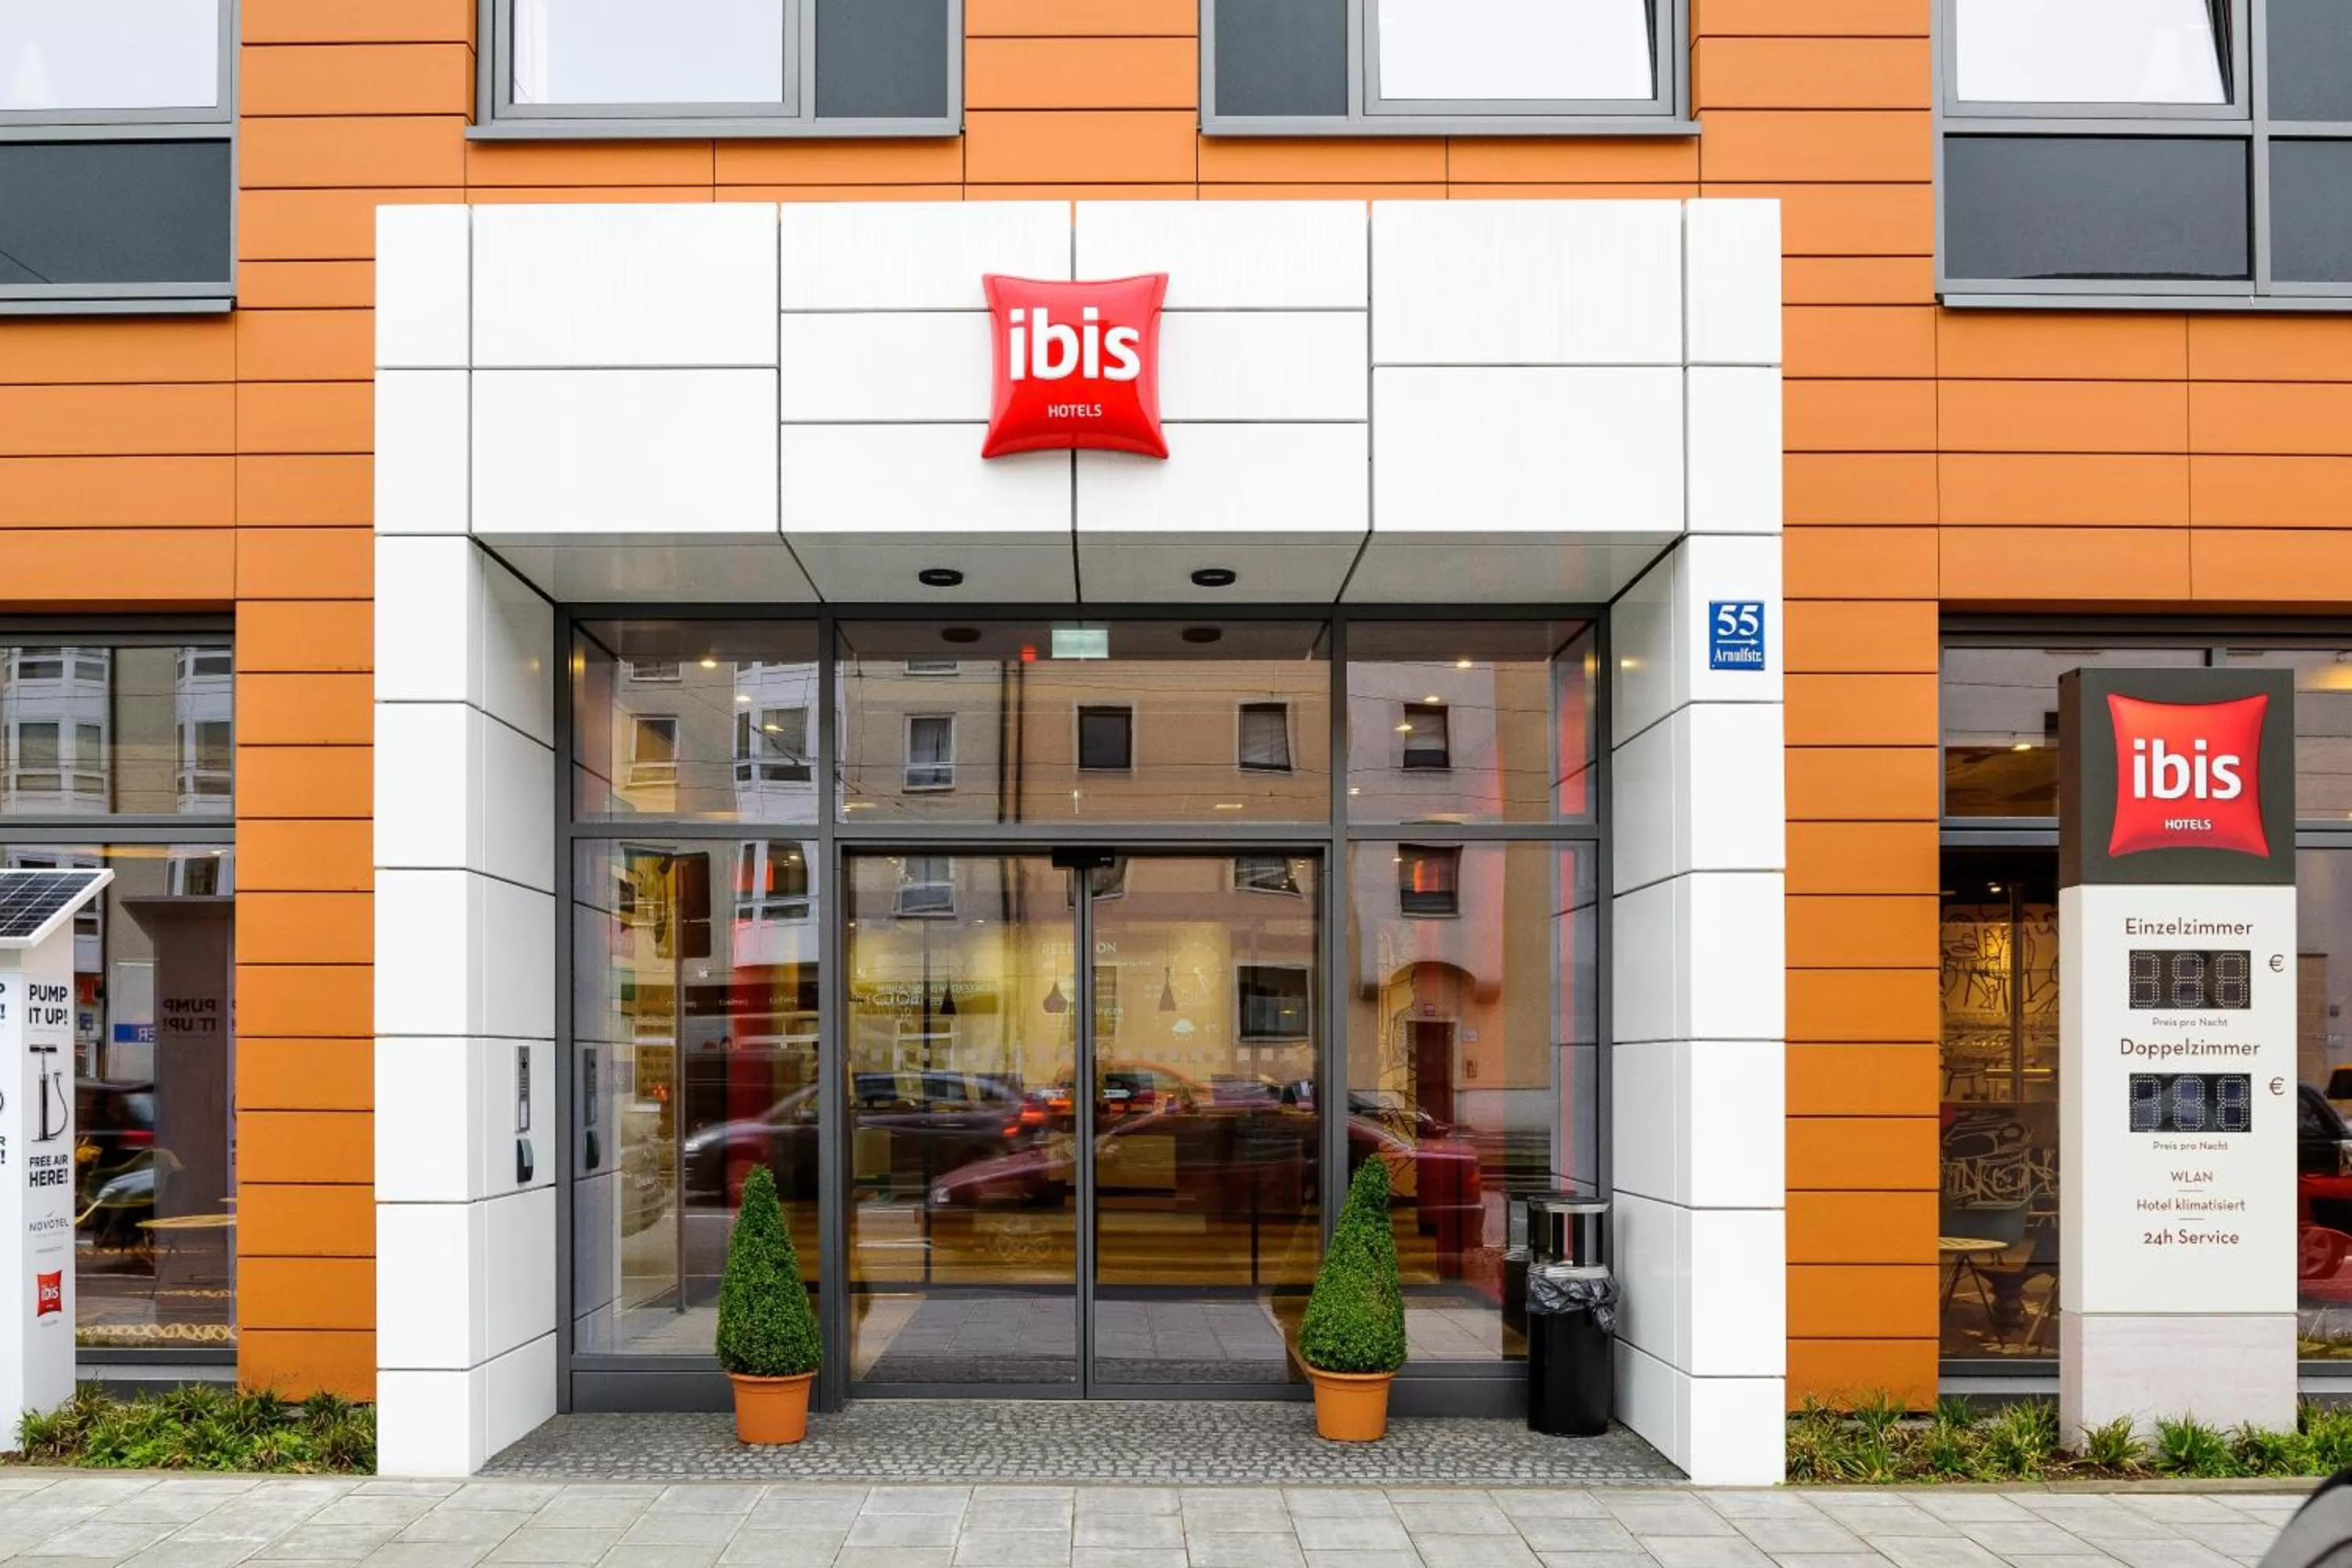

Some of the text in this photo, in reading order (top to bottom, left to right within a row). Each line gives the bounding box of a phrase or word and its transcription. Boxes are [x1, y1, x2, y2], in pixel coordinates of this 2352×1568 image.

[1009, 307, 1142, 381] ibis
[1047, 404, 1103, 418] HOTELS
[1717, 604, 1759, 636] 55
[2133, 738, 2242, 800] ibis
[2165, 819, 2212, 830] HOTELS
[2125, 916, 2254, 935] Einzelzimmer
[2268, 953, 2285, 973] €
[29, 984, 68, 1003] PUMP
[29, 1007, 68, 1025] IT UP!
[2152, 1017, 2228, 1029] Preis pro Nacht
[2120, 1037, 2261, 1059] Doppelzimmer
[2268, 1076, 2285, 1095] €
[2152, 1141, 2177, 1150] Preis
[2199, 1141, 2228, 1150] Nacht
[29, 1153, 68, 1167] FREE AIR
[29, 1167, 68, 1188] HERE!
[2169, 1170, 2213, 1183] WLAN
[2136, 1197, 2246, 1211] Hotel klimatisiert
[29, 1218, 69, 1232] NOVOTEL
[2143, 1229, 2240, 1246] 24h Service
